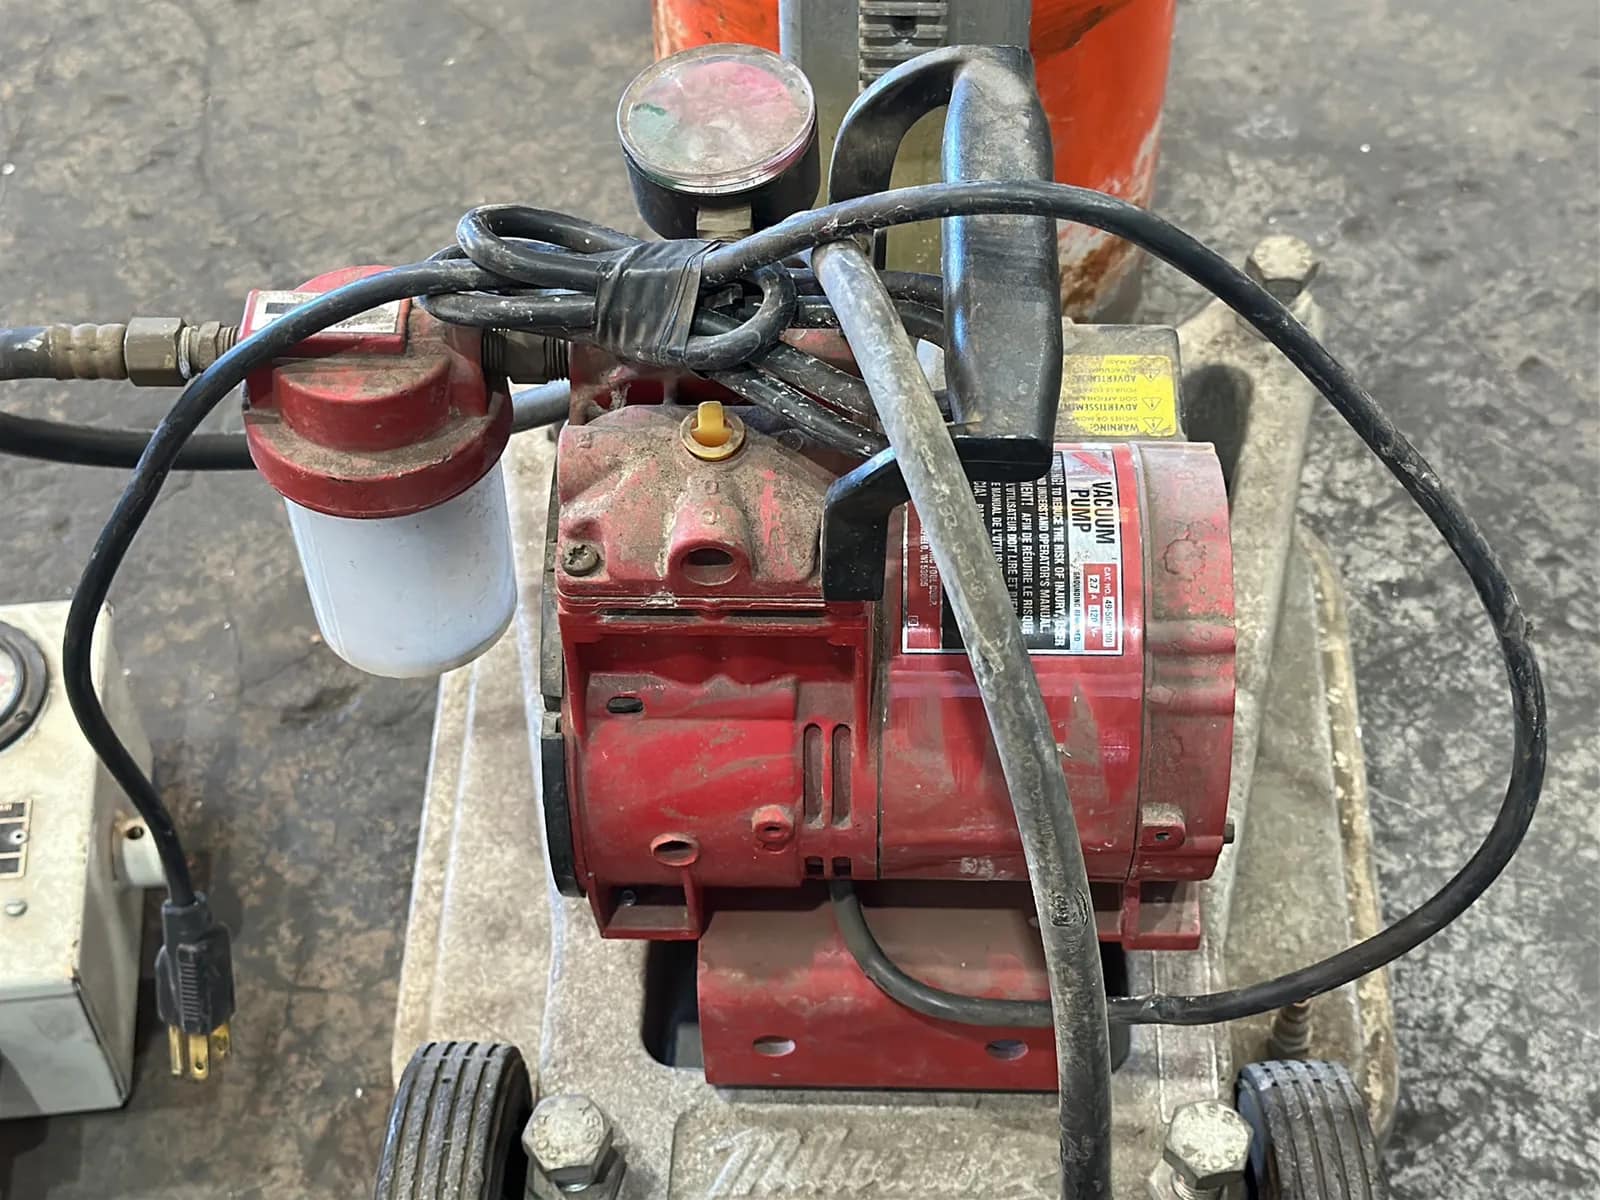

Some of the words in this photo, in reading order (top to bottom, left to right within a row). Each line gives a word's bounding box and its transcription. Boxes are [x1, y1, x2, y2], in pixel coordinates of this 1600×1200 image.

[1090, 423, 1139, 432] WARNING:
[1051, 487, 1062, 496] TO
[1005, 482, 1017, 532] L'UTILISATEUR
[1037, 486, 1049, 531] UNDERSTAND
[1052, 497, 1063, 525] REDUCE
[1070, 489, 1092, 533] PUMP
[1092, 481, 1115, 544] VACUUM
[992, 517, 1002, 527] DE
[1020, 512, 1032, 530] AFIN
[1006, 533, 1018, 553] DOIT
[1021, 532, 1032, 543] DE
[1053, 527, 1064, 543] THE
[1039, 533, 1050, 587] OPERATOR'S
[1054, 544, 1065, 564] RISK
[929, 565, 938, 583] TOOL
[1007, 555, 1018, 575] LIRE
[1022, 545, 1036, 584] RÉDUIRE
[1054, 567, 1065, 579] OF
[1103, 566, 1111, 581] CAT.
[1007, 577, 1018, 590] ET
[1022, 585, 1033, 597] LE
[1073, 571, 1081, 608] GROUNDING
[1090, 577, 1098, 589] 2.7
[1103, 583, 1111, 596] NO.
[1053, 581, 1066, 617] INJURY,
[1022, 599, 1034, 635] RISQUE
[1039, 589, 1051, 633] MANUAL.
[1054, 620, 1066, 647] USER
